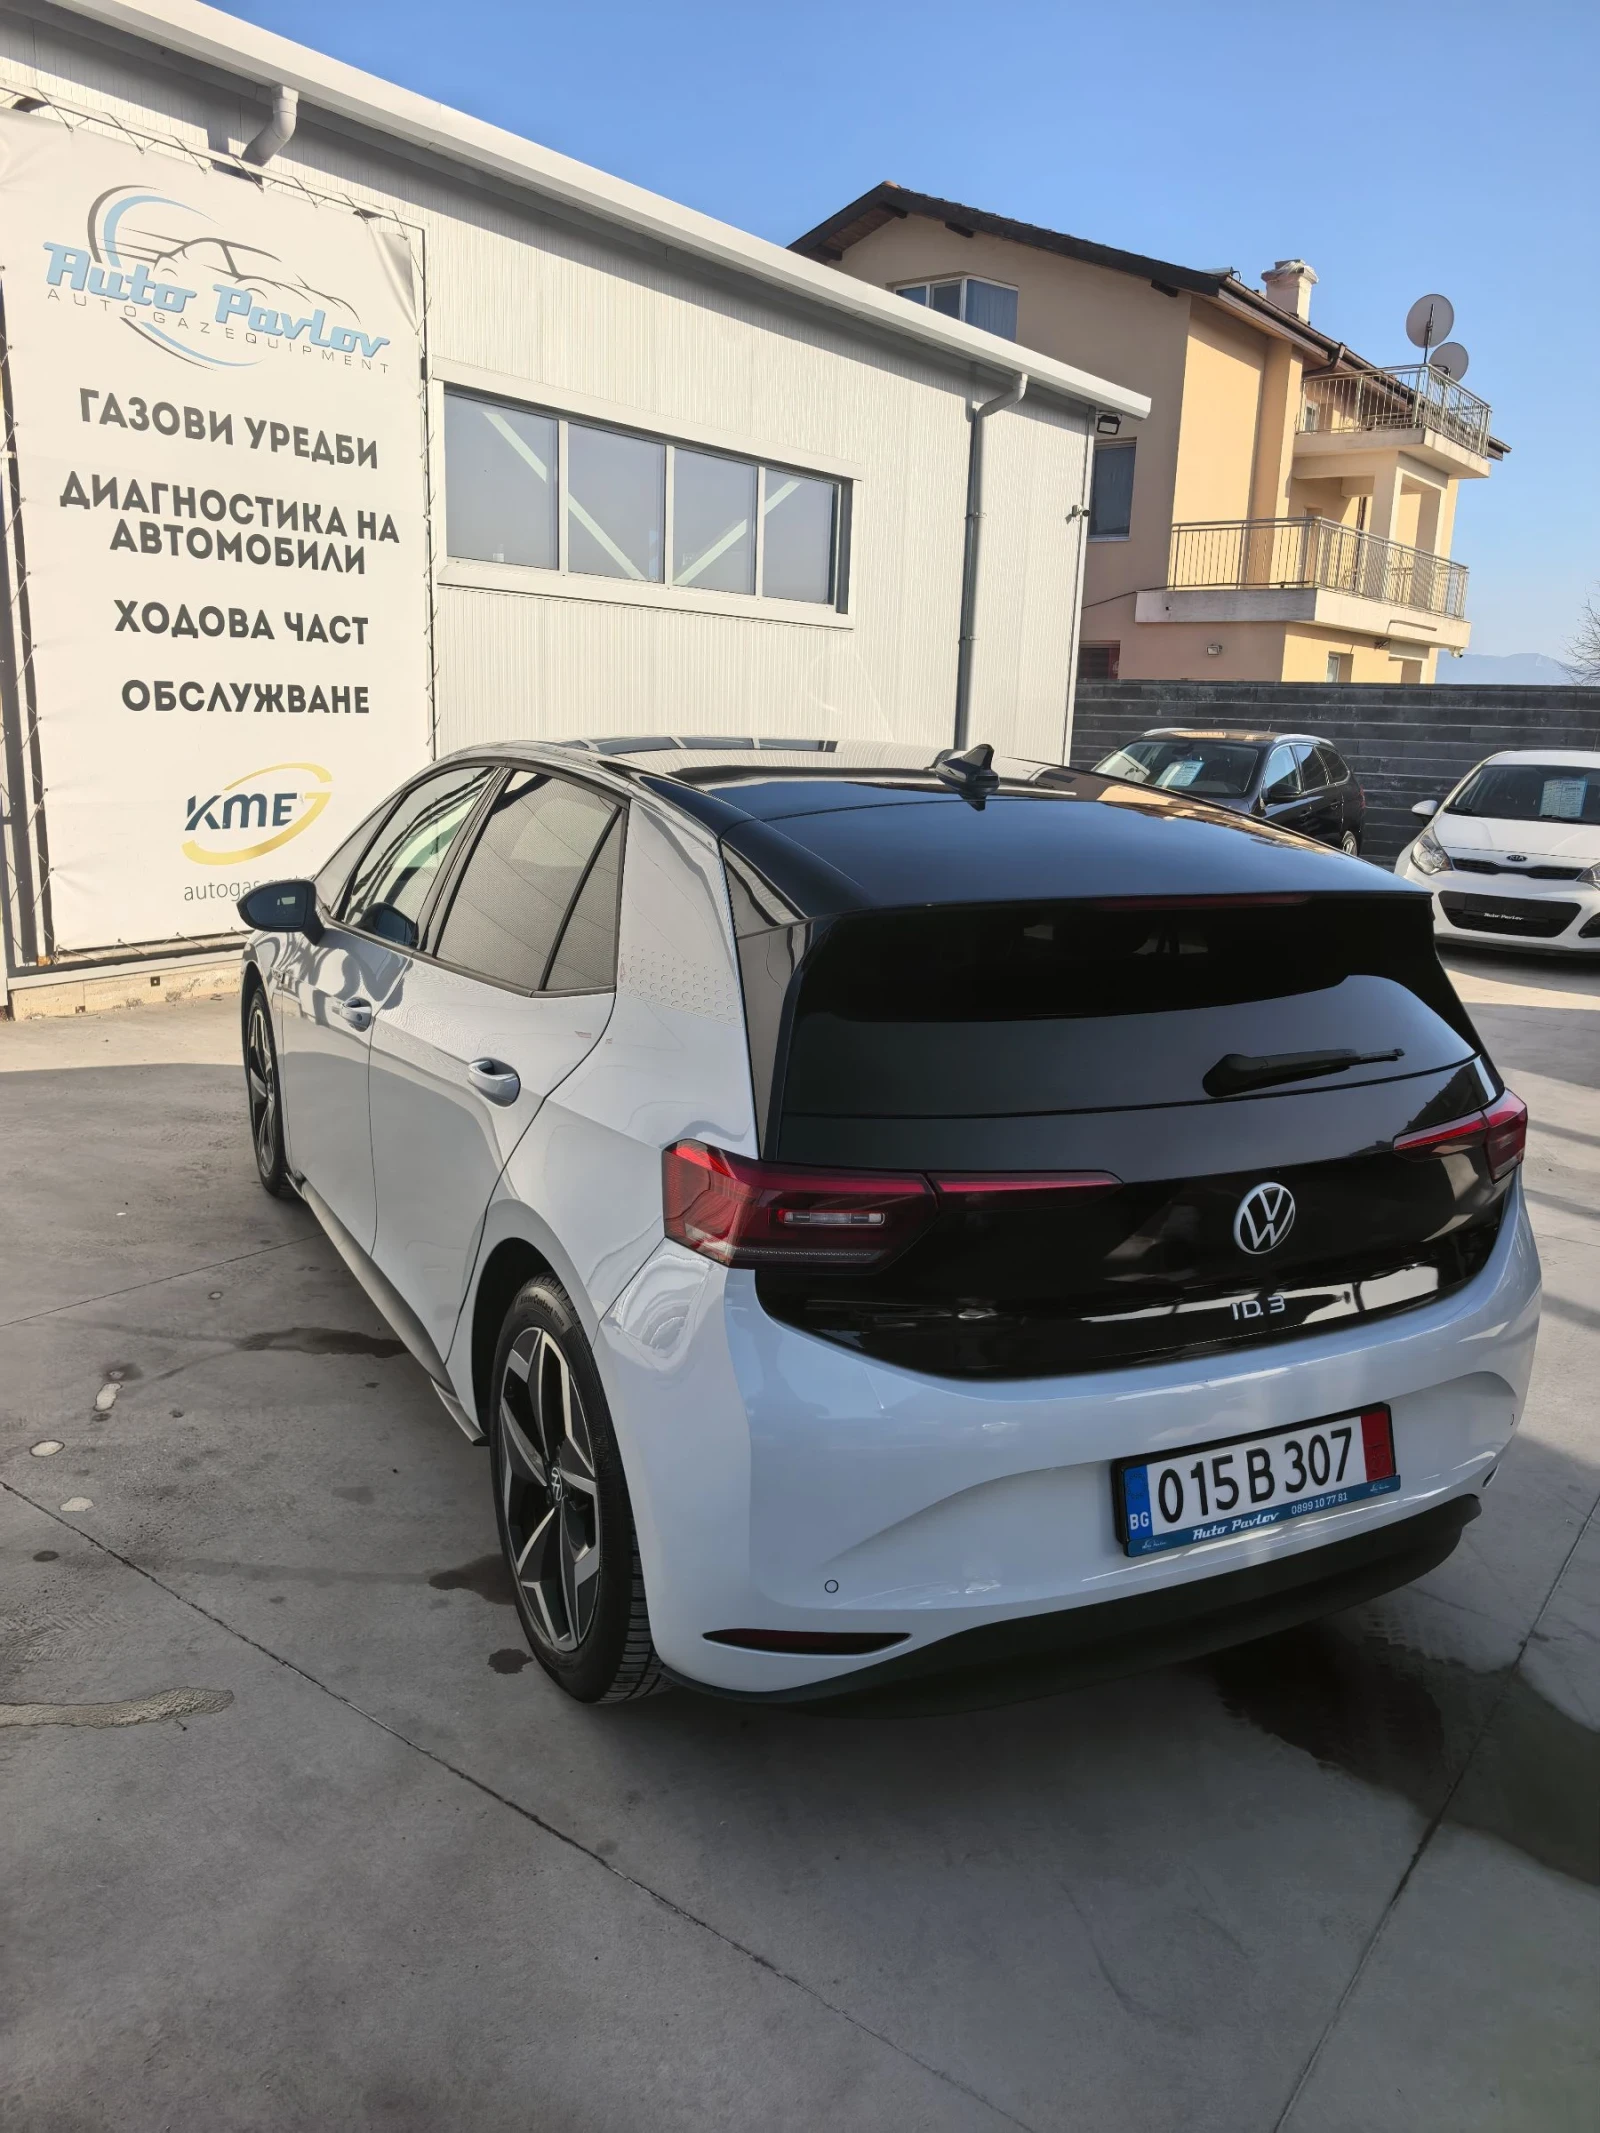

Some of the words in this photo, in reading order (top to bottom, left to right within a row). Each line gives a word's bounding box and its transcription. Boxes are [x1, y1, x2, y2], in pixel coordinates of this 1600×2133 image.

[43, 241, 197, 313] Auto
[213, 284, 391, 358] Pavlov
[80, 388, 234, 445] ГАЗОВИ
[243, 417, 378, 470] УРЕДБИ
[60, 471, 348, 537] ДИАГНОСТИКА
[357, 510, 400, 544] НА
[110, 519, 366, 575] АВТОМОБИЛИ
[114, 600, 276, 640] ХОДОВА
[283, 612, 369, 645] ЧАСТ
[122, 679, 370, 714] ОБСЛУЖВАНЕ
[184, 793, 298, 831] KME
[1129, 1511, 1150, 1530] BG
[1291, 1501, 1314, 1515] 0899
[1315, 1497, 1326, 1509] 10
[1326, 1494, 1338, 1505] 77
[1337, 1491, 1349, 1502] 81
[1192, 1525, 1228, 1541] Auto
[1231, 1512, 1280, 1532] Pavlov
